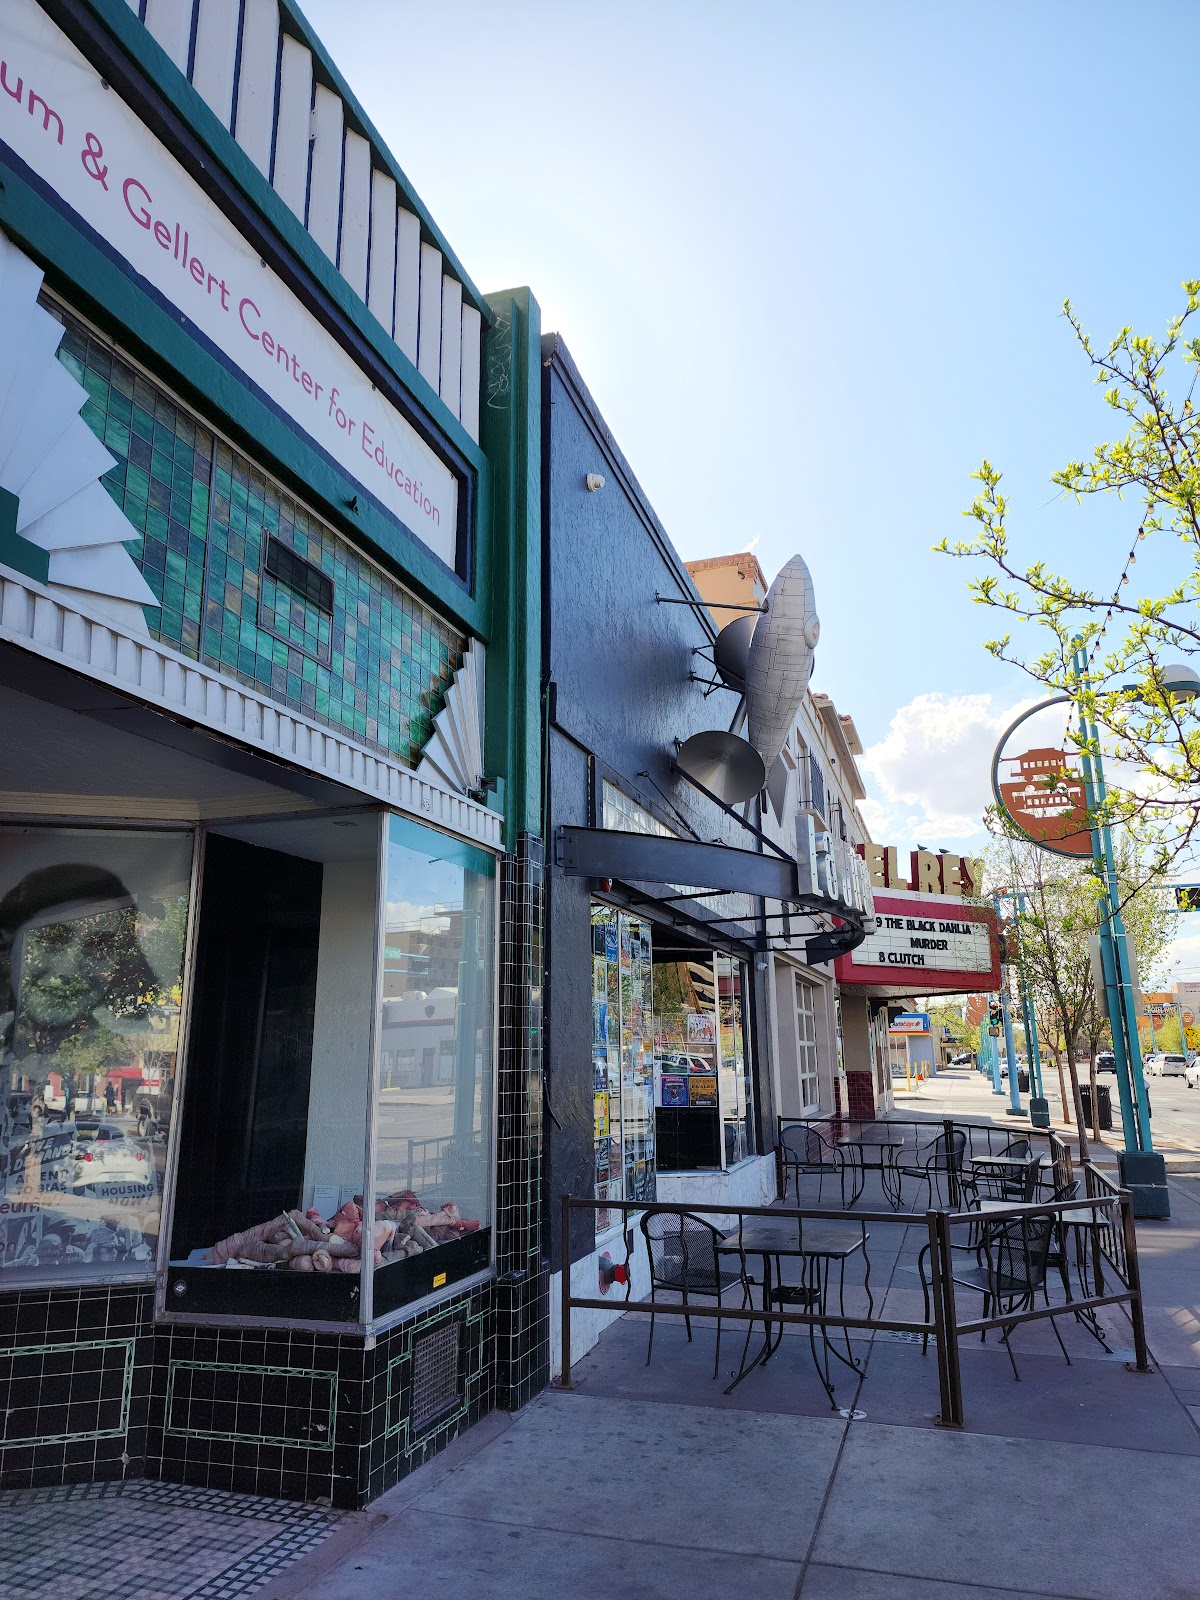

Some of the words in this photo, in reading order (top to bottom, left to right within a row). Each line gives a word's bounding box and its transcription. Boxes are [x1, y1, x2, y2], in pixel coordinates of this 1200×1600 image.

[81, 132, 109, 191] &
[122, 177, 230, 311] Gellert
[239, 298, 323, 400] Center
[329, 387, 356, 437] for
[360, 424, 441, 526] Education
[885, 917, 904, 930] THE
[906, 919, 936, 932] BLACK
[938, 922, 972, 935] DAHLIA
[910, 937, 949, 951] MURDER
[887, 952, 925, 966] CLUTCH
[101, 1183, 155, 1196] HOUSING
